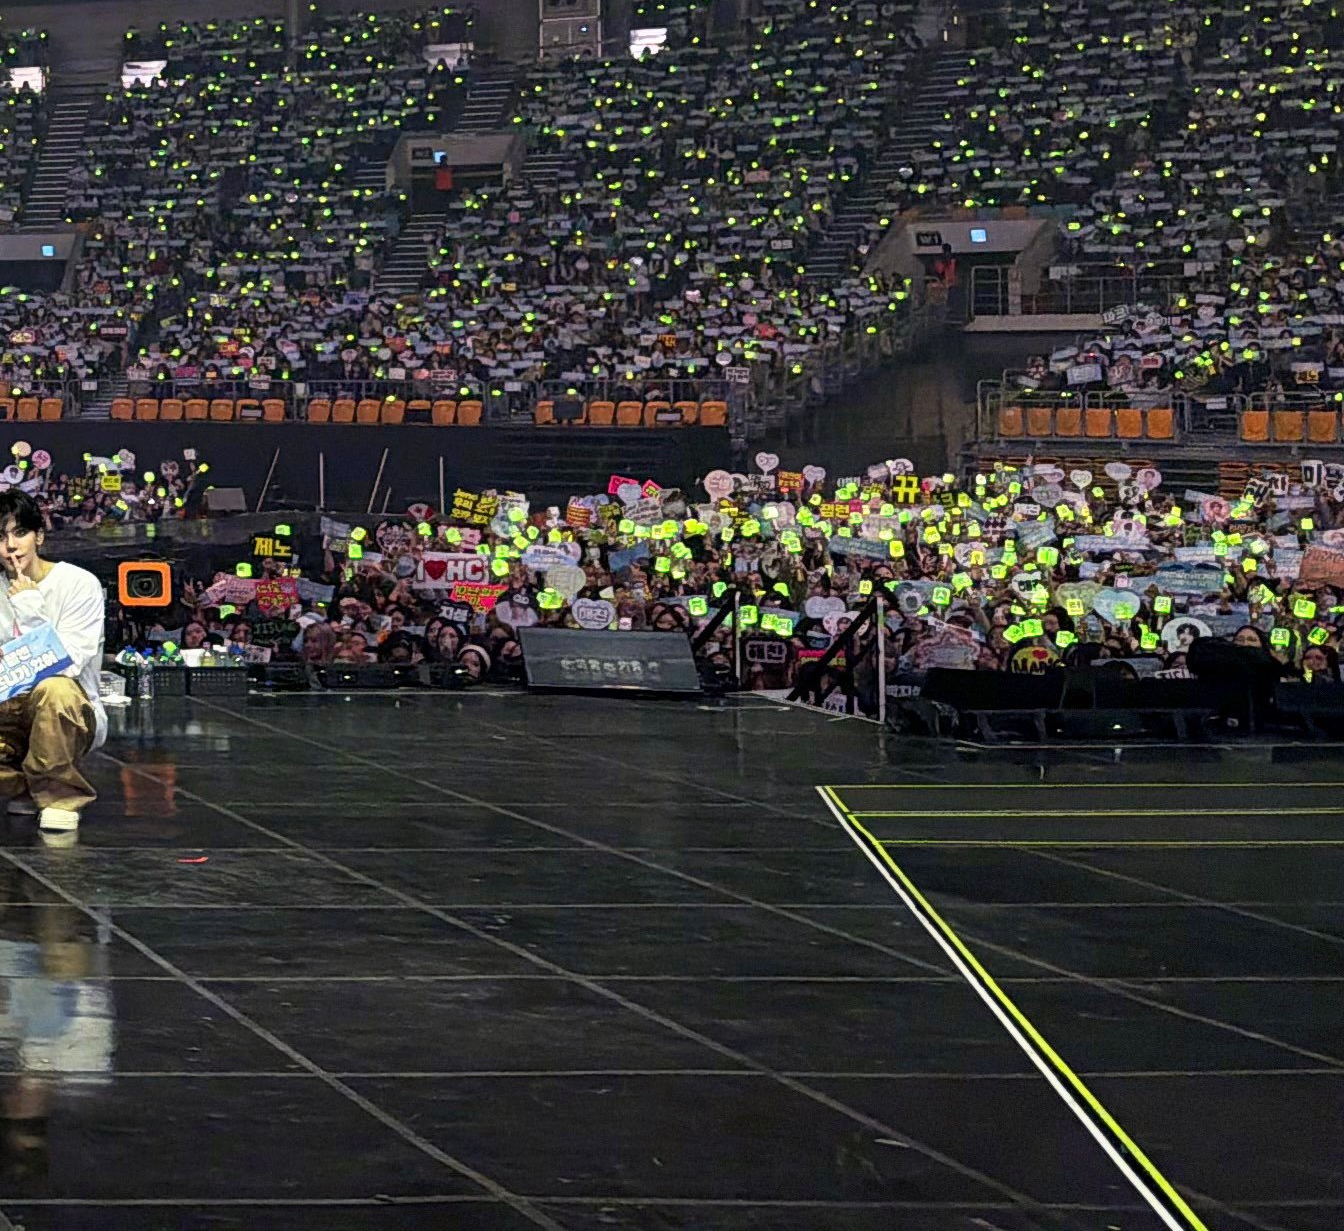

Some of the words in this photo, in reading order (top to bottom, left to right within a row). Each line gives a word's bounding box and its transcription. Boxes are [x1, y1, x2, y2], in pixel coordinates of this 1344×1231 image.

[253, 537, 292, 557] 제노
[446, 559, 484, 582] HC
[748, 642, 785, 661] 해찬
